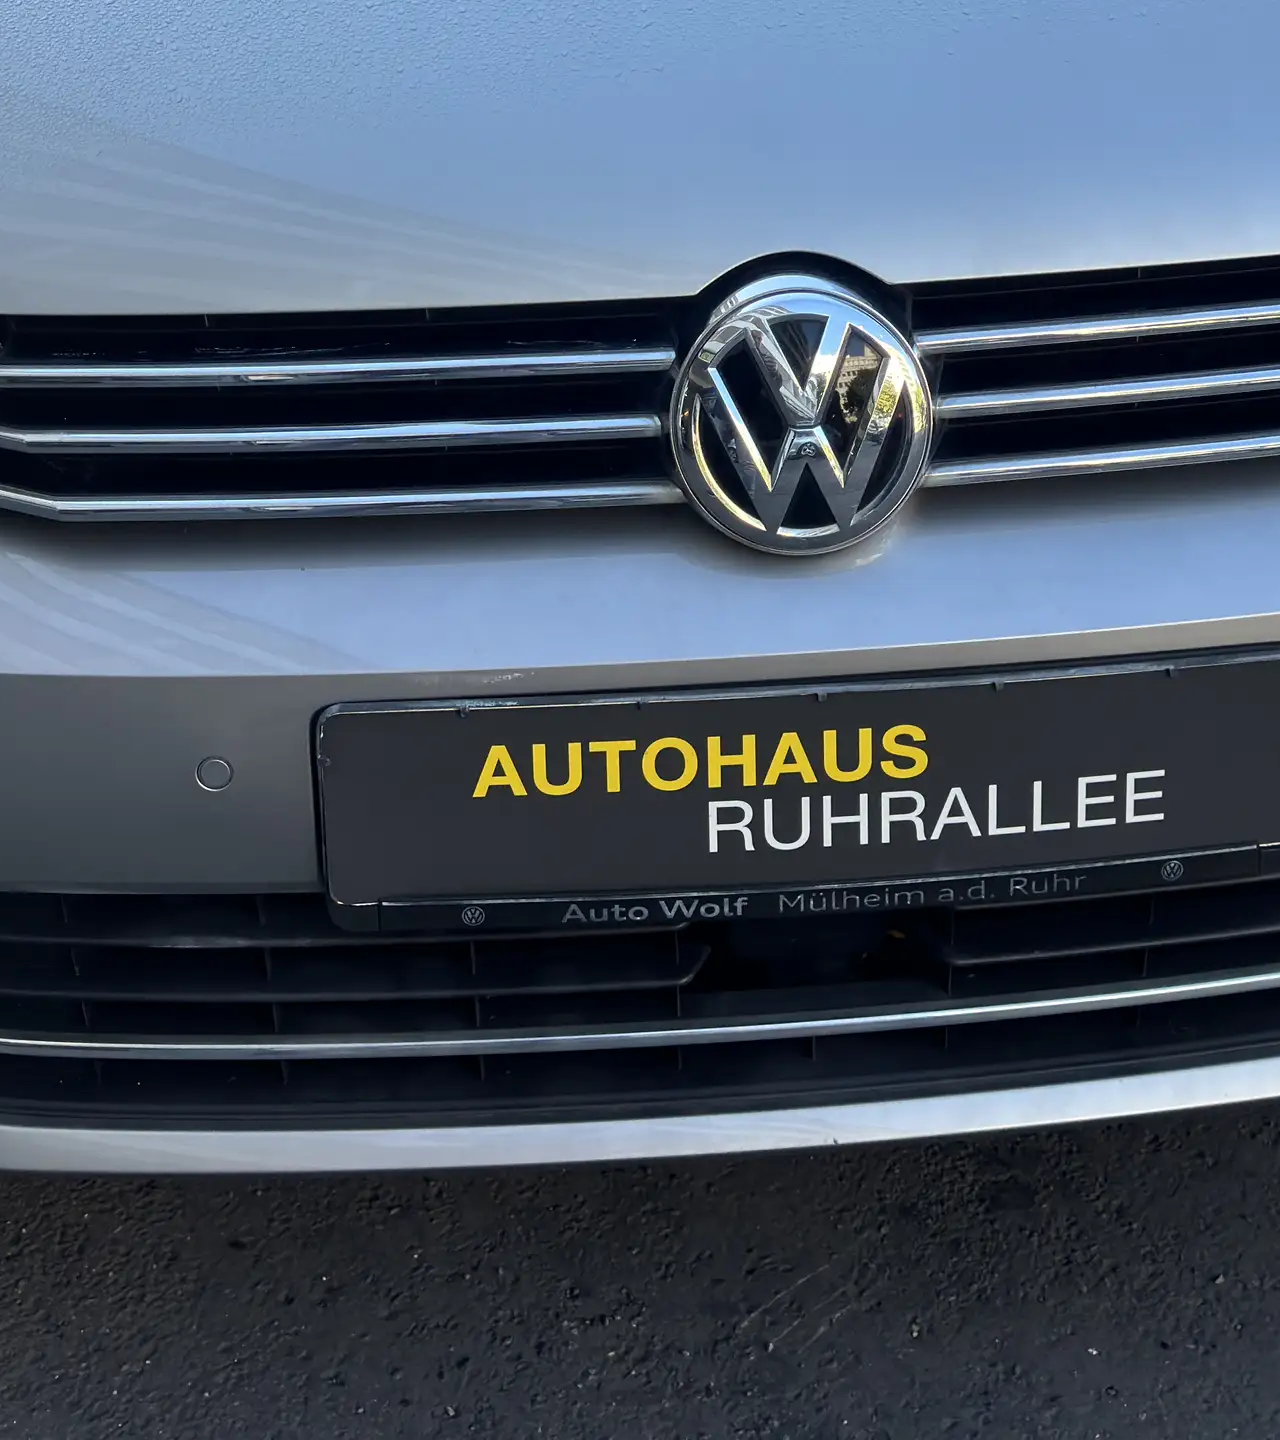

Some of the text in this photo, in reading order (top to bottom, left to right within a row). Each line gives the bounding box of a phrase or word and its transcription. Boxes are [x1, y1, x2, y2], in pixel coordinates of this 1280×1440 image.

[472, 724, 929, 799] AUTOHAUS
[707, 769, 1167, 853] RUHRALLEE
[561, 872, 1088, 924] Auto Wolf Mülheim a.d. Ruhr
